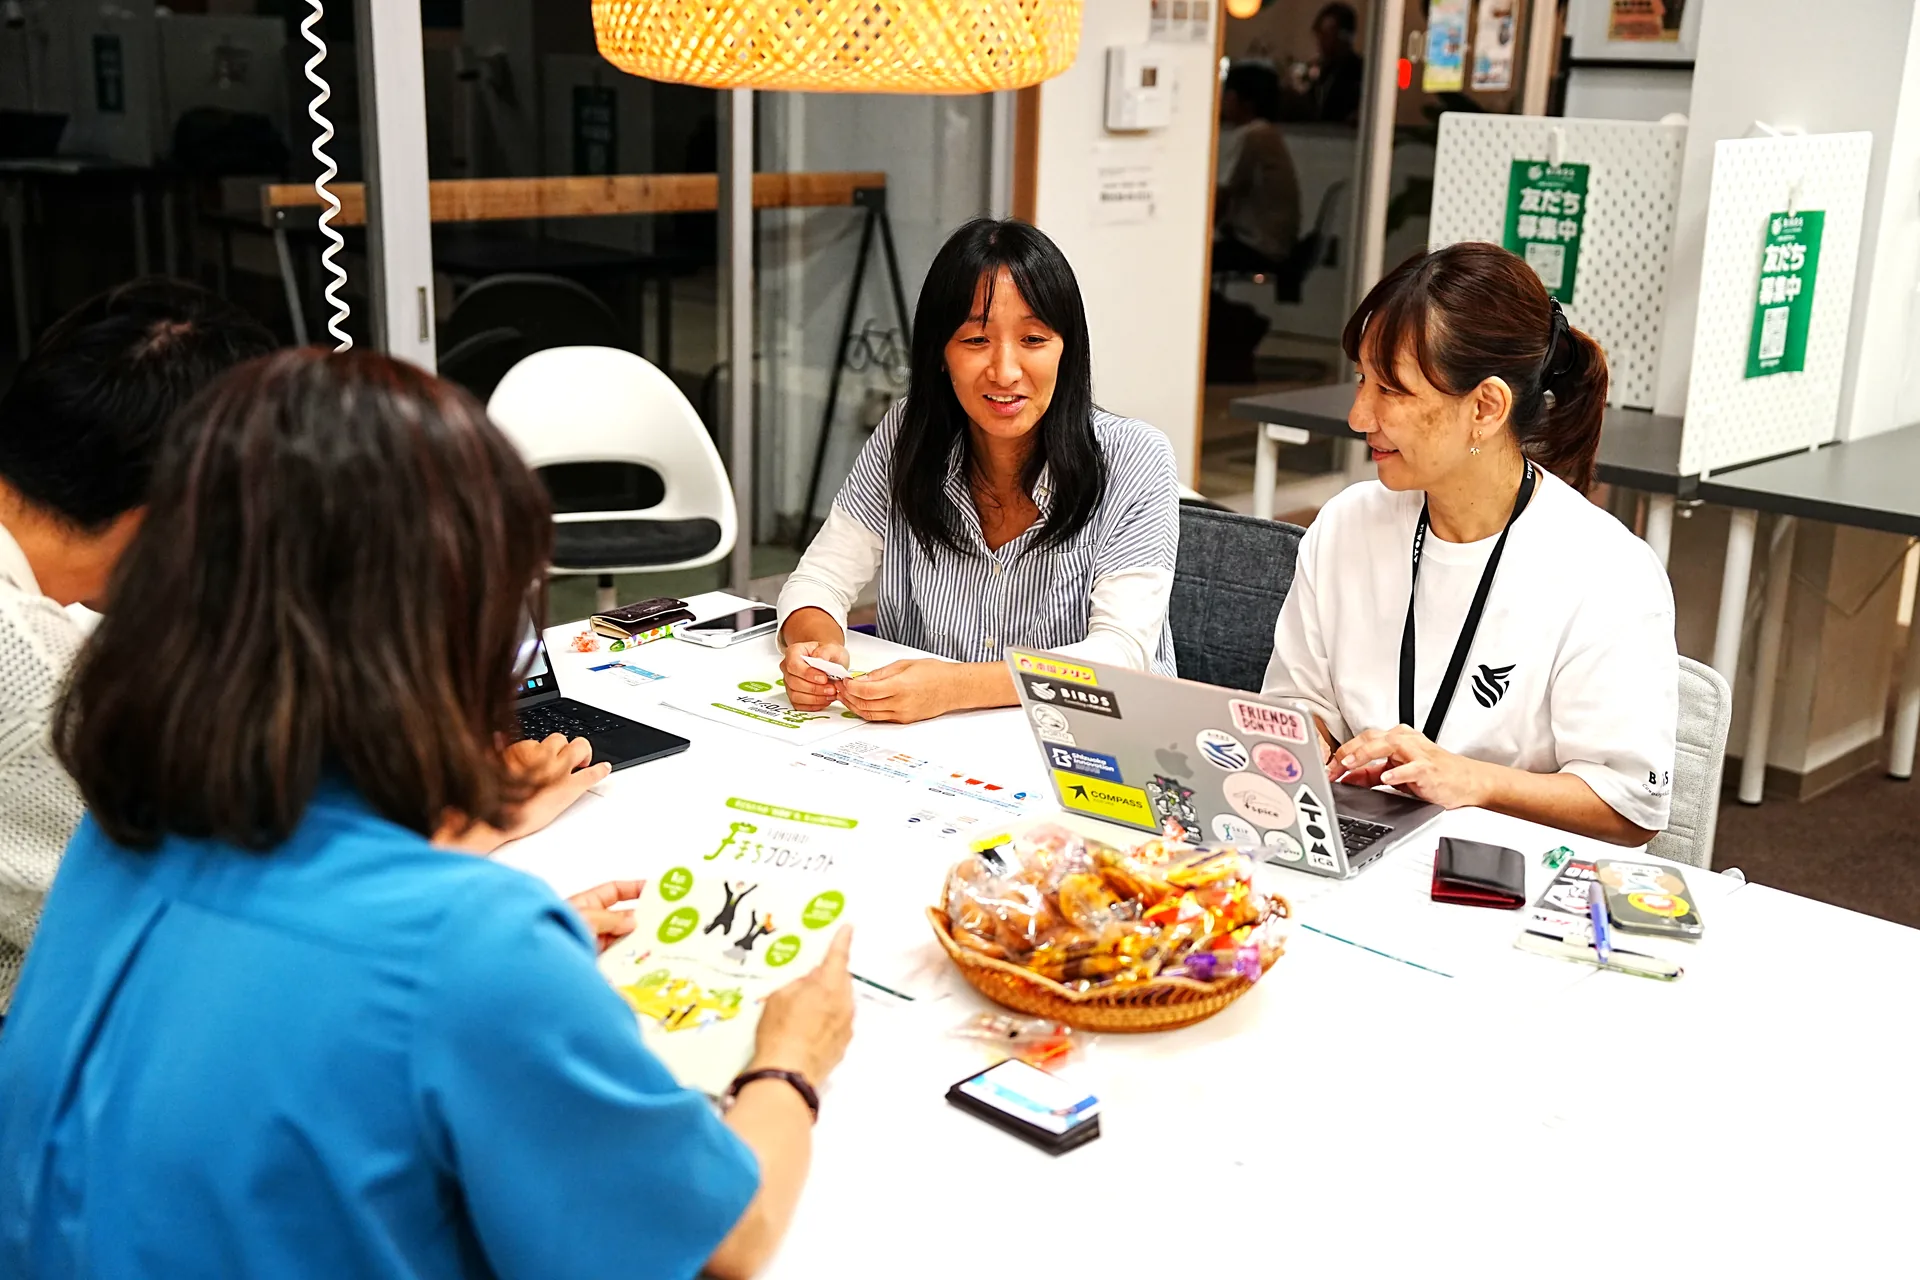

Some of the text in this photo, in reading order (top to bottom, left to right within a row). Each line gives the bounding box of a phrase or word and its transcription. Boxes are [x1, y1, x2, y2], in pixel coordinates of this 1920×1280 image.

[1519, 187, 1581, 215] 友だち
[1762, 242, 1807, 273] 友だち
[1060, 687, 1110, 707] BIRDS
[1238, 703, 1298, 728] FRIENDS
[1091, 790, 1143, 809] COMPASS
